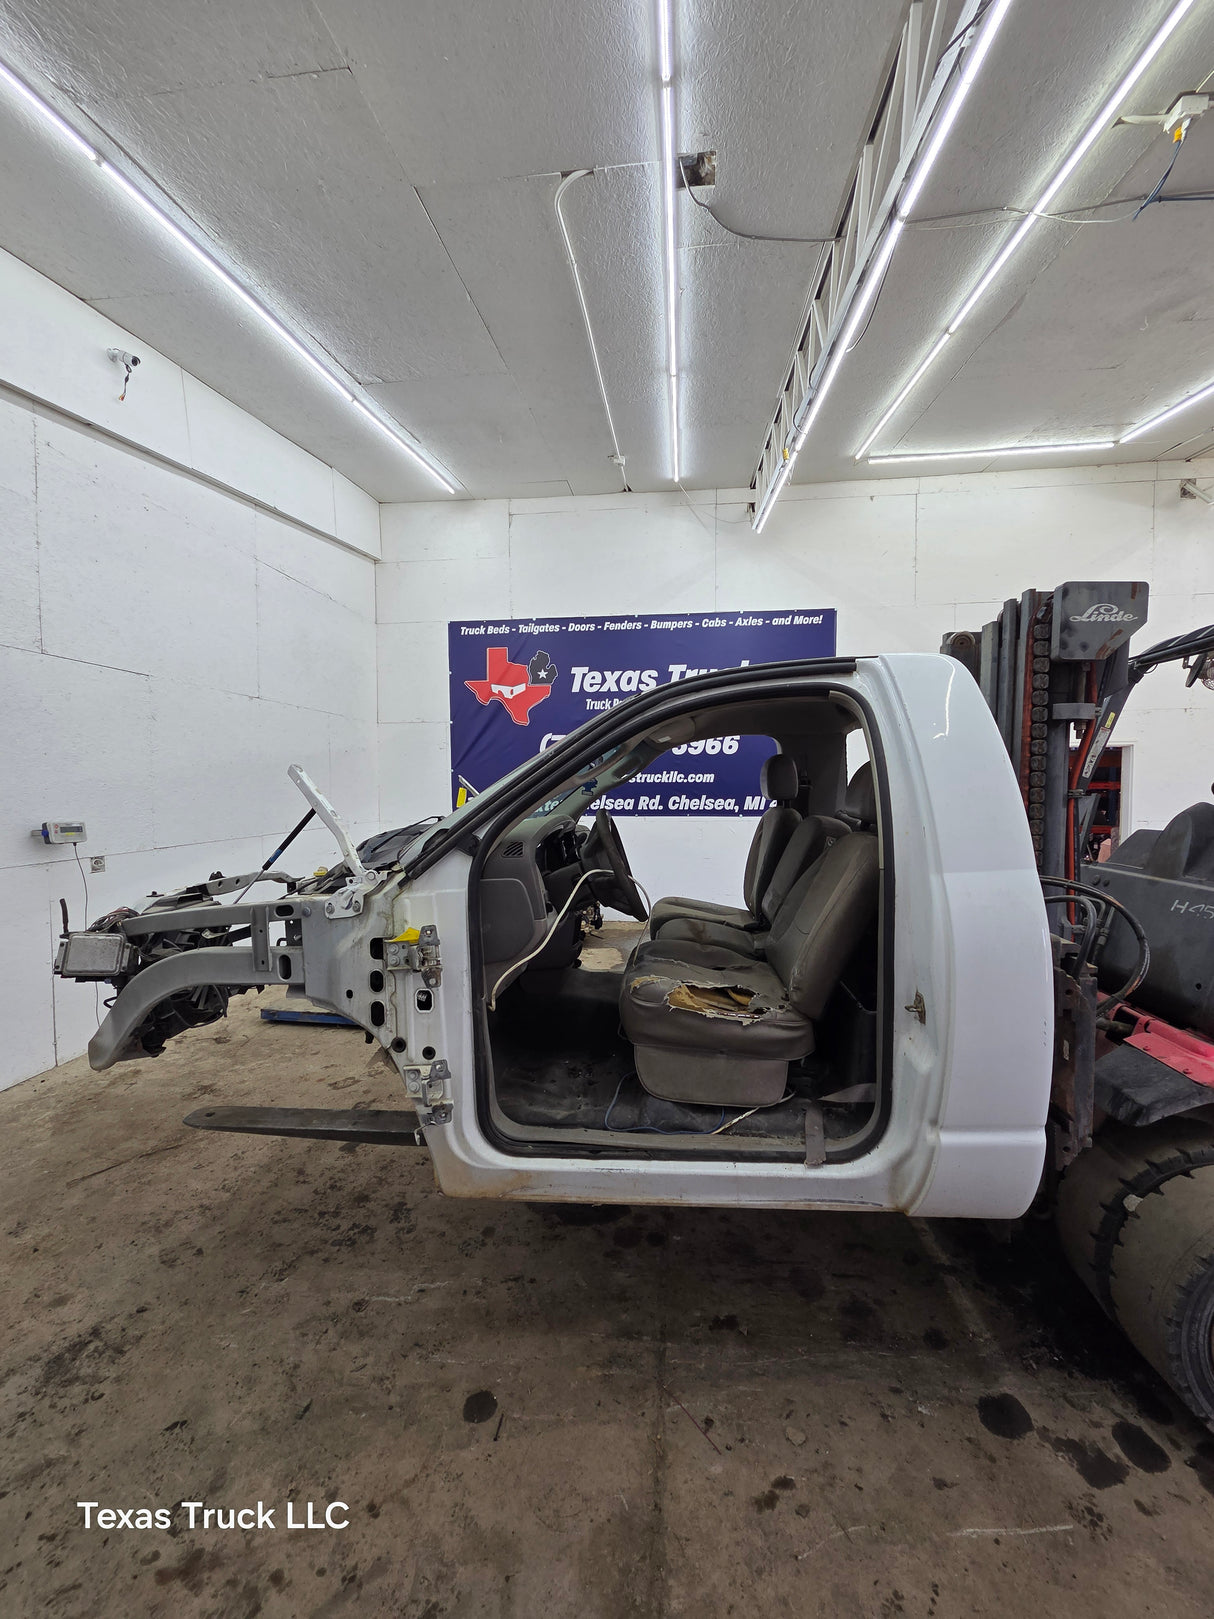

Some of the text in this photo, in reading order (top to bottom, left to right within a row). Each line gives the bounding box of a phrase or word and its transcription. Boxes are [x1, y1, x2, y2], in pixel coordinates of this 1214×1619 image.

[1069, 603, 1138, 621] Linde
[460, 625, 486, 636] Truck
[487, 624, 510, 635] Beds
[518, 622, 560, 635] Tailgates
[568, 622, 596, 632] Doors
[603, 620, 642, 631] Fenders
[650, 619, 693, 631] Bumpers
[701, 617, 727, 628] Cabs
[735, 616, 763, 627] Axles
[772, 615, 792, 626] and
[793, 614, 823, 625] More!
[570, 666, 659, 693] Texas
[585, 698, 612, 710] Truck
[588, 795, 635, 810] elsea
[637, 795, 663, 810] Rd.
[668, 795, 739, 813] Chelsea,
[743, 796, 767, 810] MI
